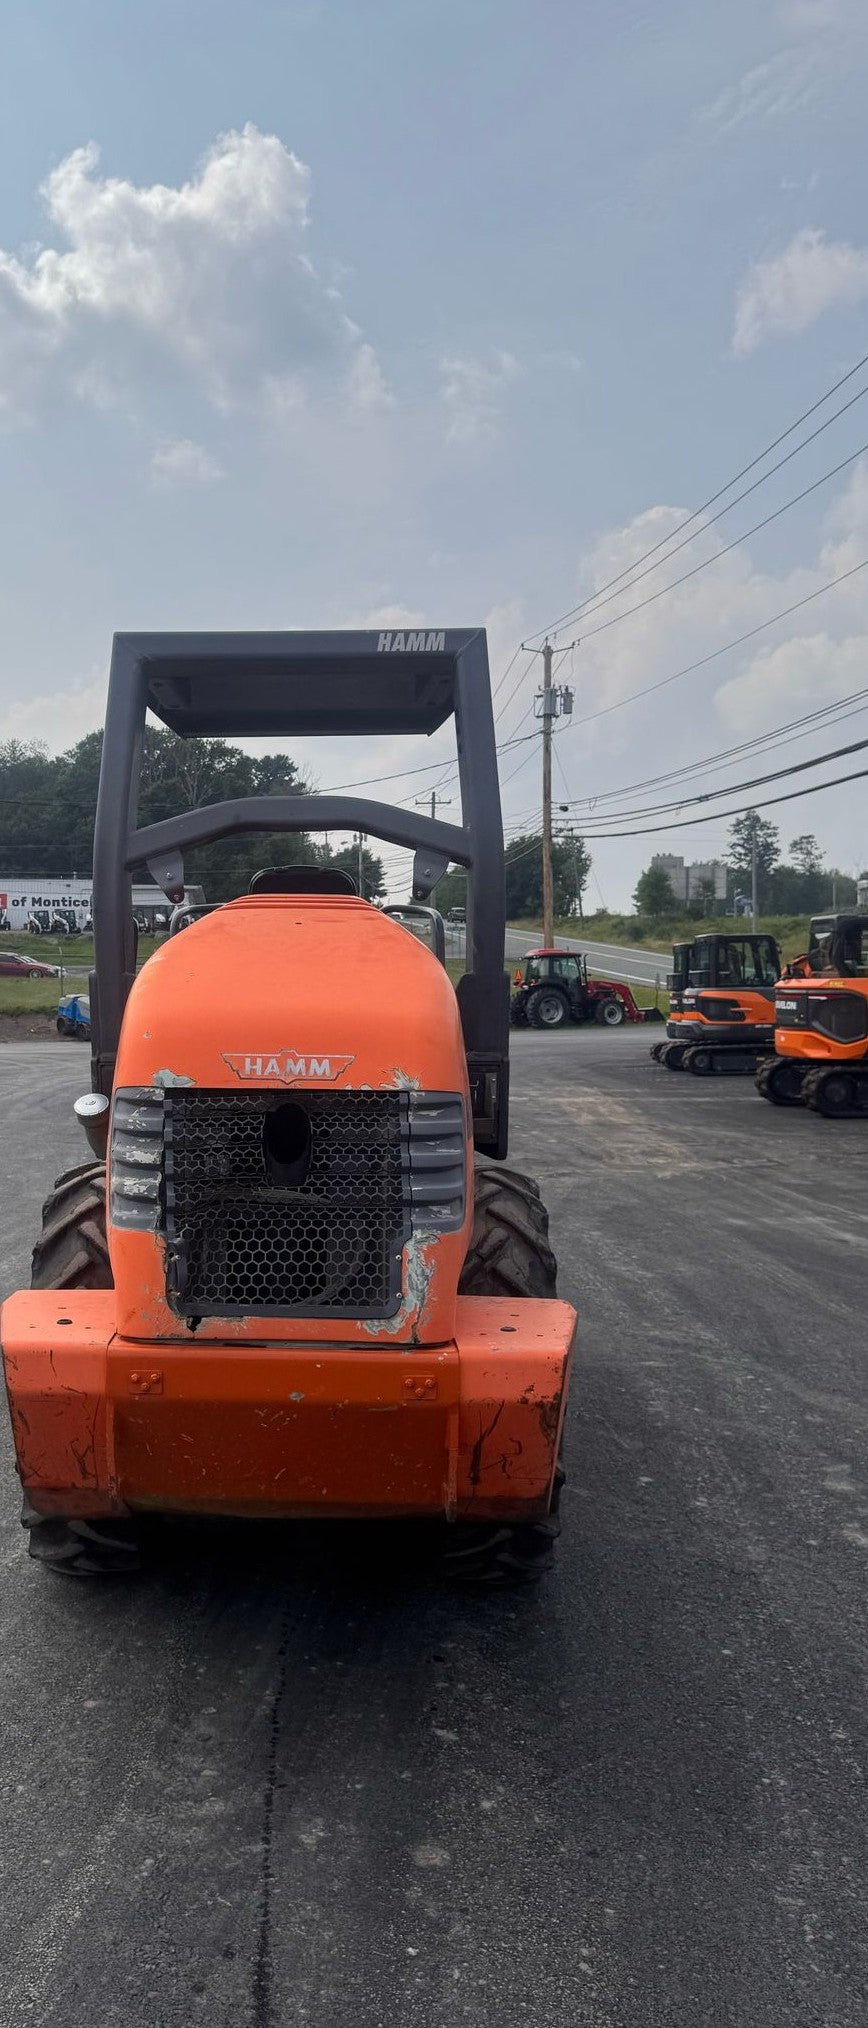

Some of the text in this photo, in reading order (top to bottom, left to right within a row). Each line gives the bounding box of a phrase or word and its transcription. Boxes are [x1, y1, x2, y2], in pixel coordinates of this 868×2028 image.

[377, 632, 446, 652] HAMM
[11, 896, 27, 907] of
[244, 1057, 332, 1077] HAMM
